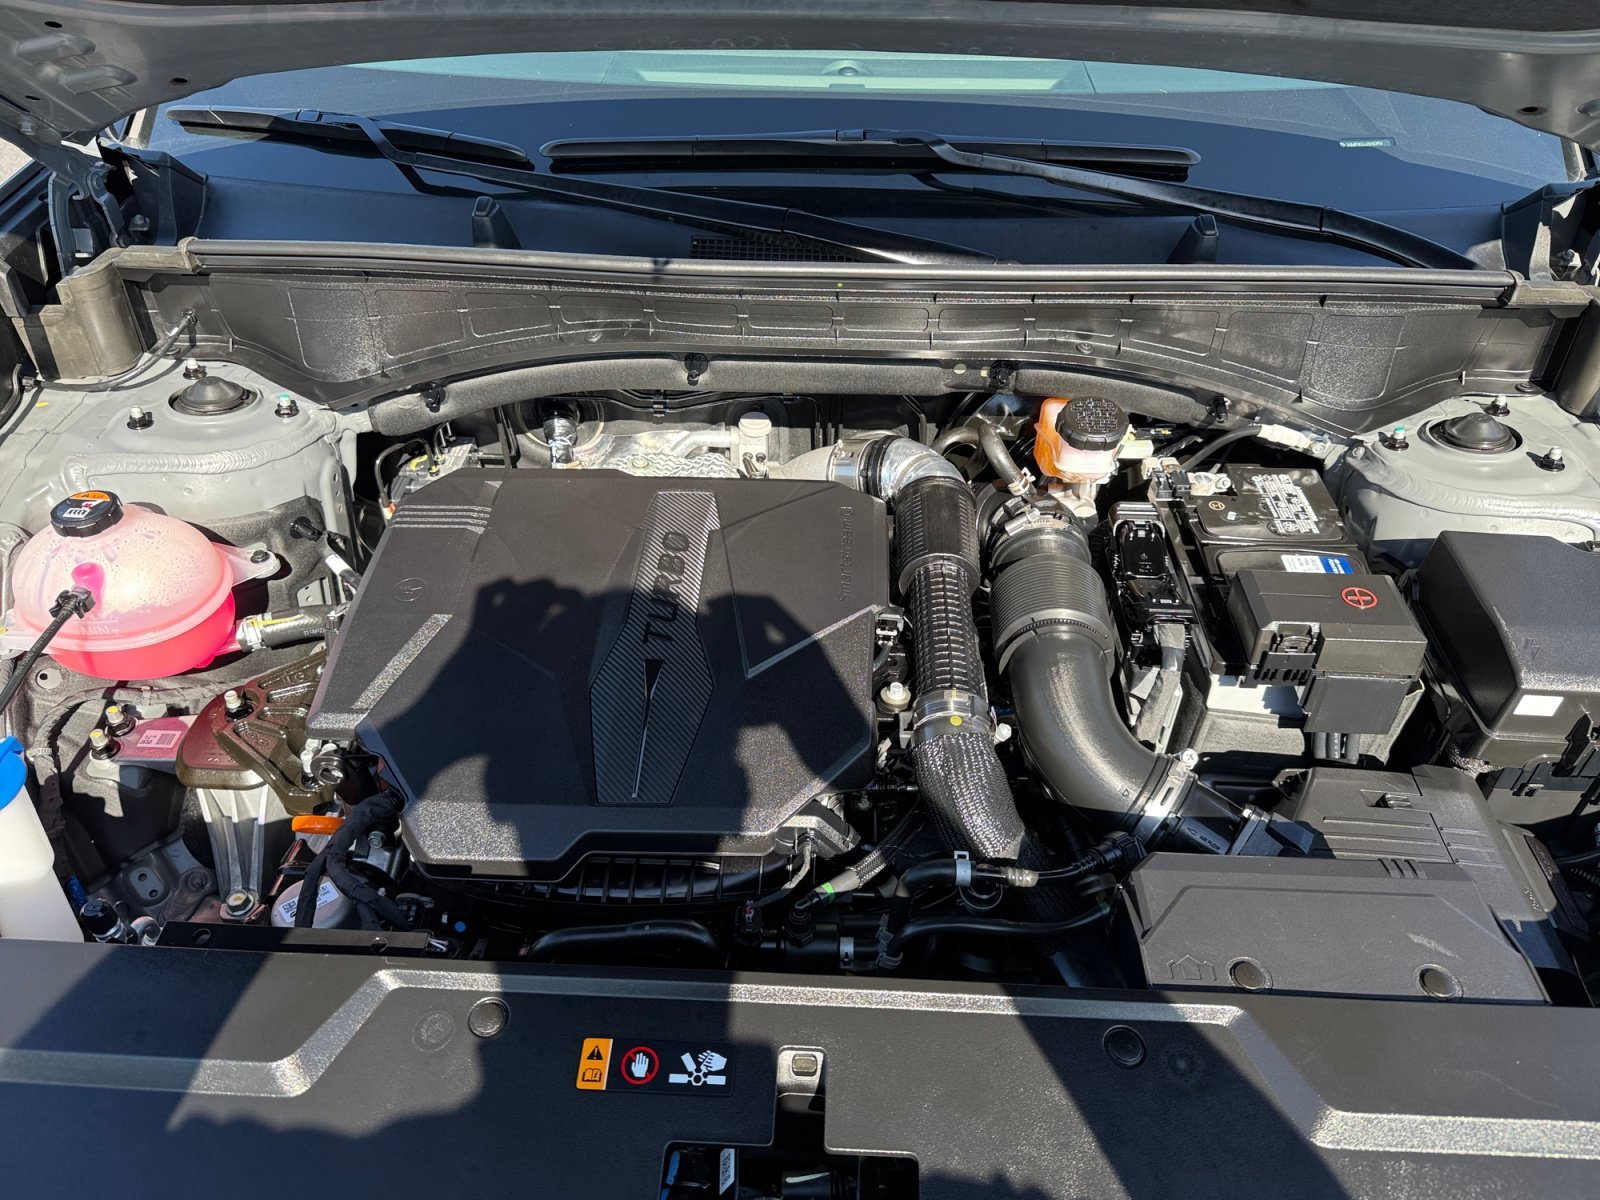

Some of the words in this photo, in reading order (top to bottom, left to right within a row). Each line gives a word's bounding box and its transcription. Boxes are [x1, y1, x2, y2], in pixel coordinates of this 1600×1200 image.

[839, 518, 853, 601] Smartstream
[642, 531, 690, 646] TURBO
[80, 625, 110, 636] MIN
[1199, 835, 1208, 843] AIR
[1207, 840, 1221, 851] FLOW
